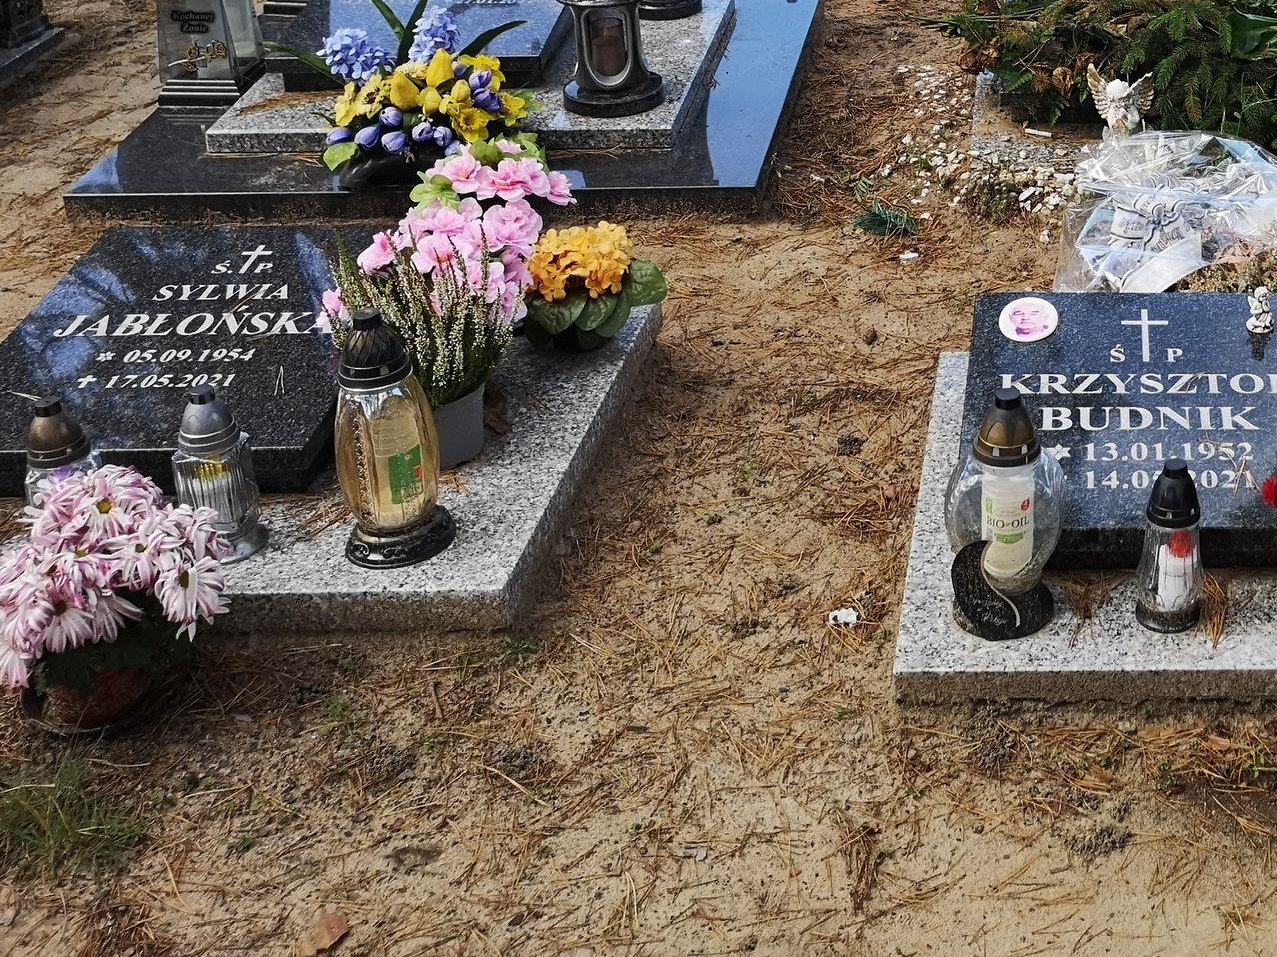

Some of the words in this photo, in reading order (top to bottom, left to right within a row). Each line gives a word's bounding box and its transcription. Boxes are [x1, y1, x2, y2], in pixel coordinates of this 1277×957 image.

[152, 283, 290, 301] SYLWIA
[123, 348, 257, 363] 05.09.1954
[1167, 348, 1184, 362] P
[104, 374, 236, 389] 17.05.2021
[1038, 406, 1261, 431] BUDNIK
[1084, 442, 1254, 462] 13.01.1952
